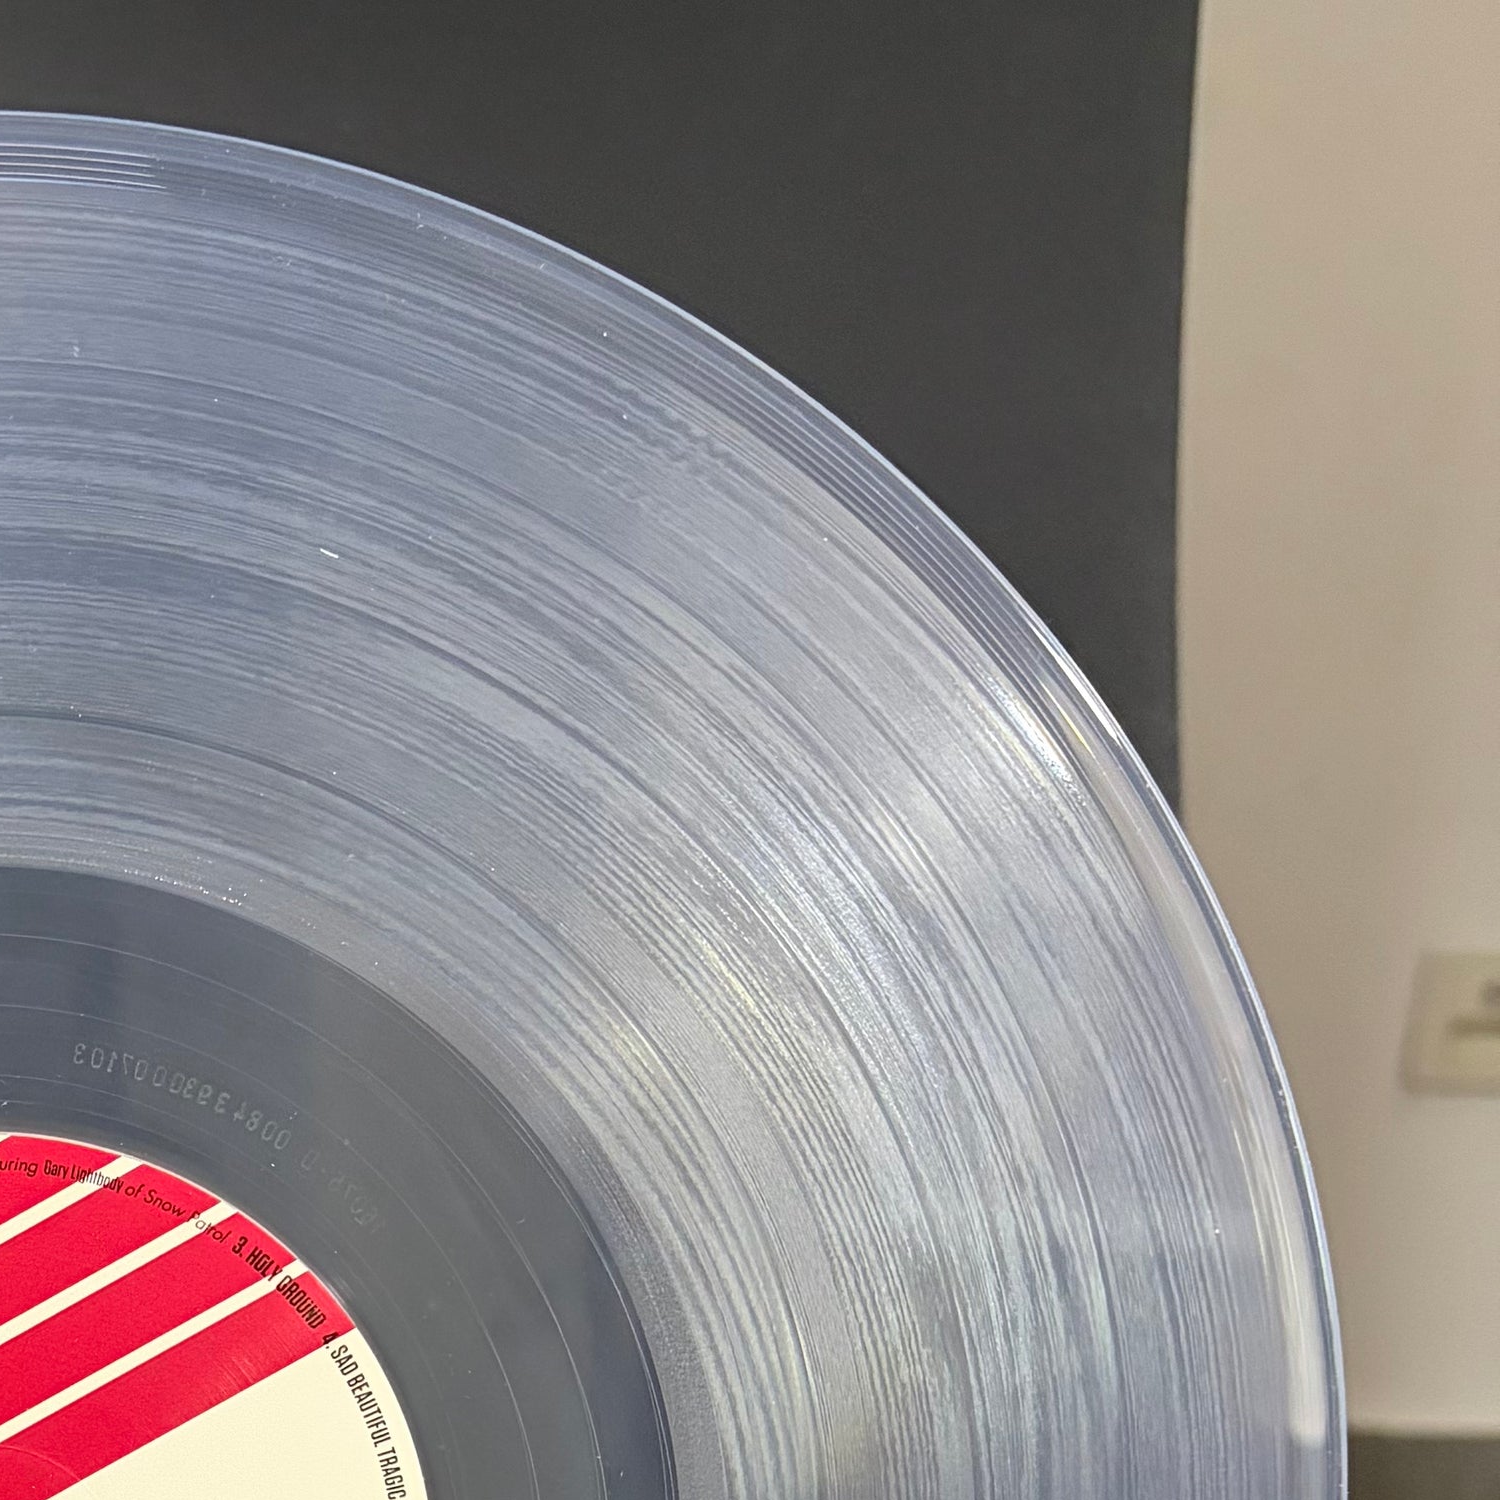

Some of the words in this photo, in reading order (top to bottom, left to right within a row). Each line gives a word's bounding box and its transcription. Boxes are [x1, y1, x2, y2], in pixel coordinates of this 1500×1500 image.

[43, 1159, 70, 1180] Gary
[70, 1163, 124, 1194] Lightbody
[124, 1183, 145, 1198] of
[143, 1189, 186, 1218] Snow
[187, 1210, 232, 1244] Patrol
[231, 1236, 249, 1258] 3.
[246, 1246, 283, 1282] HOLY
[276, 1274, 327, 1330] GROUND
[322, 1331, 340, 1350] 4.
[330, 1344, 357, 1377] SAD
[346, 1373, 391, 1448] BEAUTIFUL
[377, 1446, 407, 1500] TRAGIC
